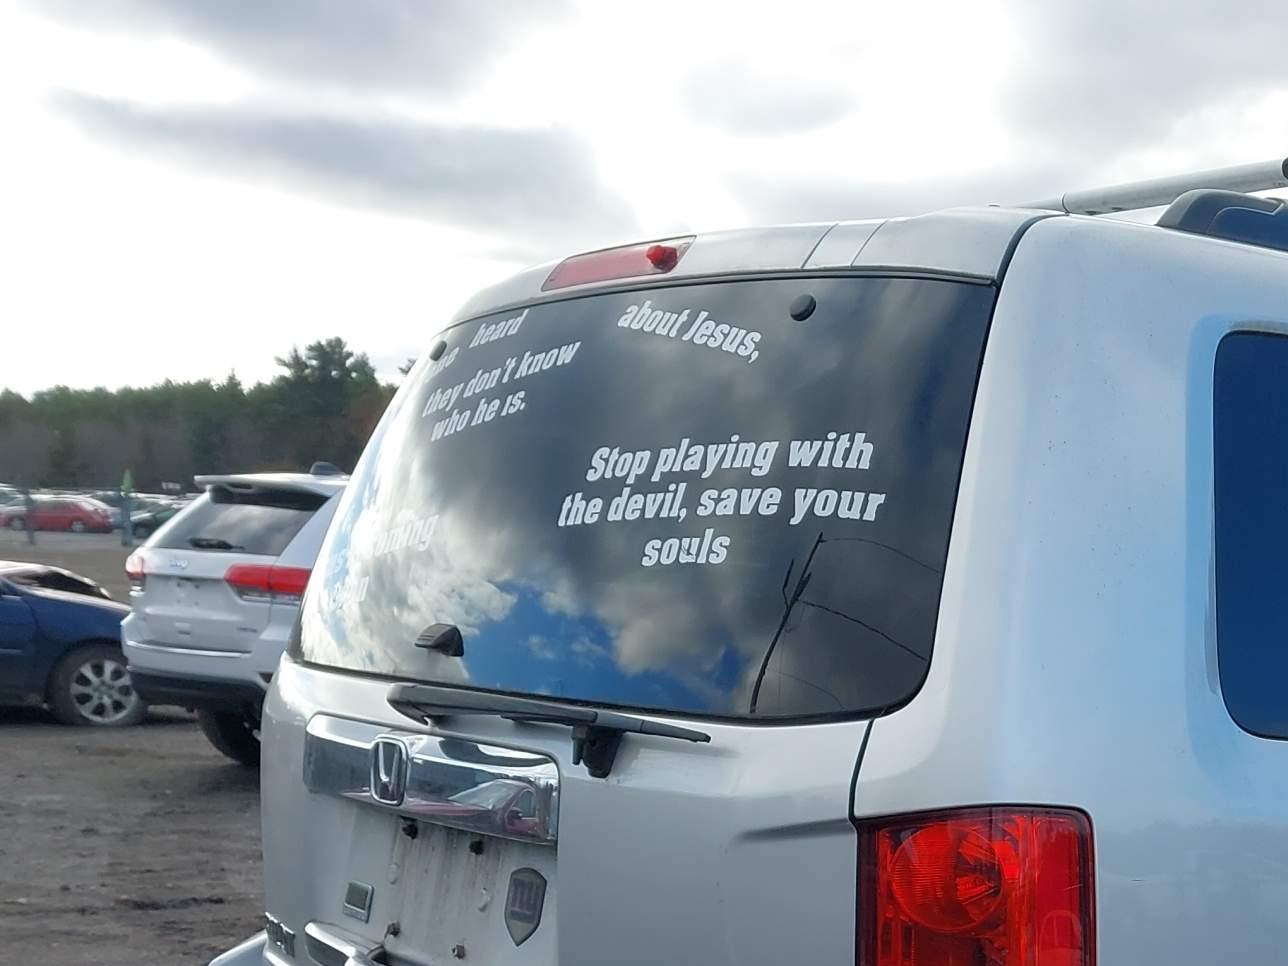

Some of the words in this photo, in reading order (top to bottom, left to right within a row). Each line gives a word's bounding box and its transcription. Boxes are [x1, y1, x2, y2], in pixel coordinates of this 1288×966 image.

[468, 308, 531, 349] heard
[617, 300, 692, 338] about
[681, 311, 762, 364] Jesus,
[422, 382, 465, 418] they
[463, 355, 518, 399] don't
[513, 341, 582, 380] know
[430, 408, 472, 442] who
[470, 398, 501, 427] he
[500, 390, 527, 417] is.
[585, 446, 651, 484] Stop
[650, 434, 780, 482] playing
[787, 431, 875, 470] with
[557, 492, 603, 527] the
[606, 482, 688, 523] devil,
[696, 487, 783, 517] save
[788, 487, 887, 526] your
[640, 527, 731, 567] souls
